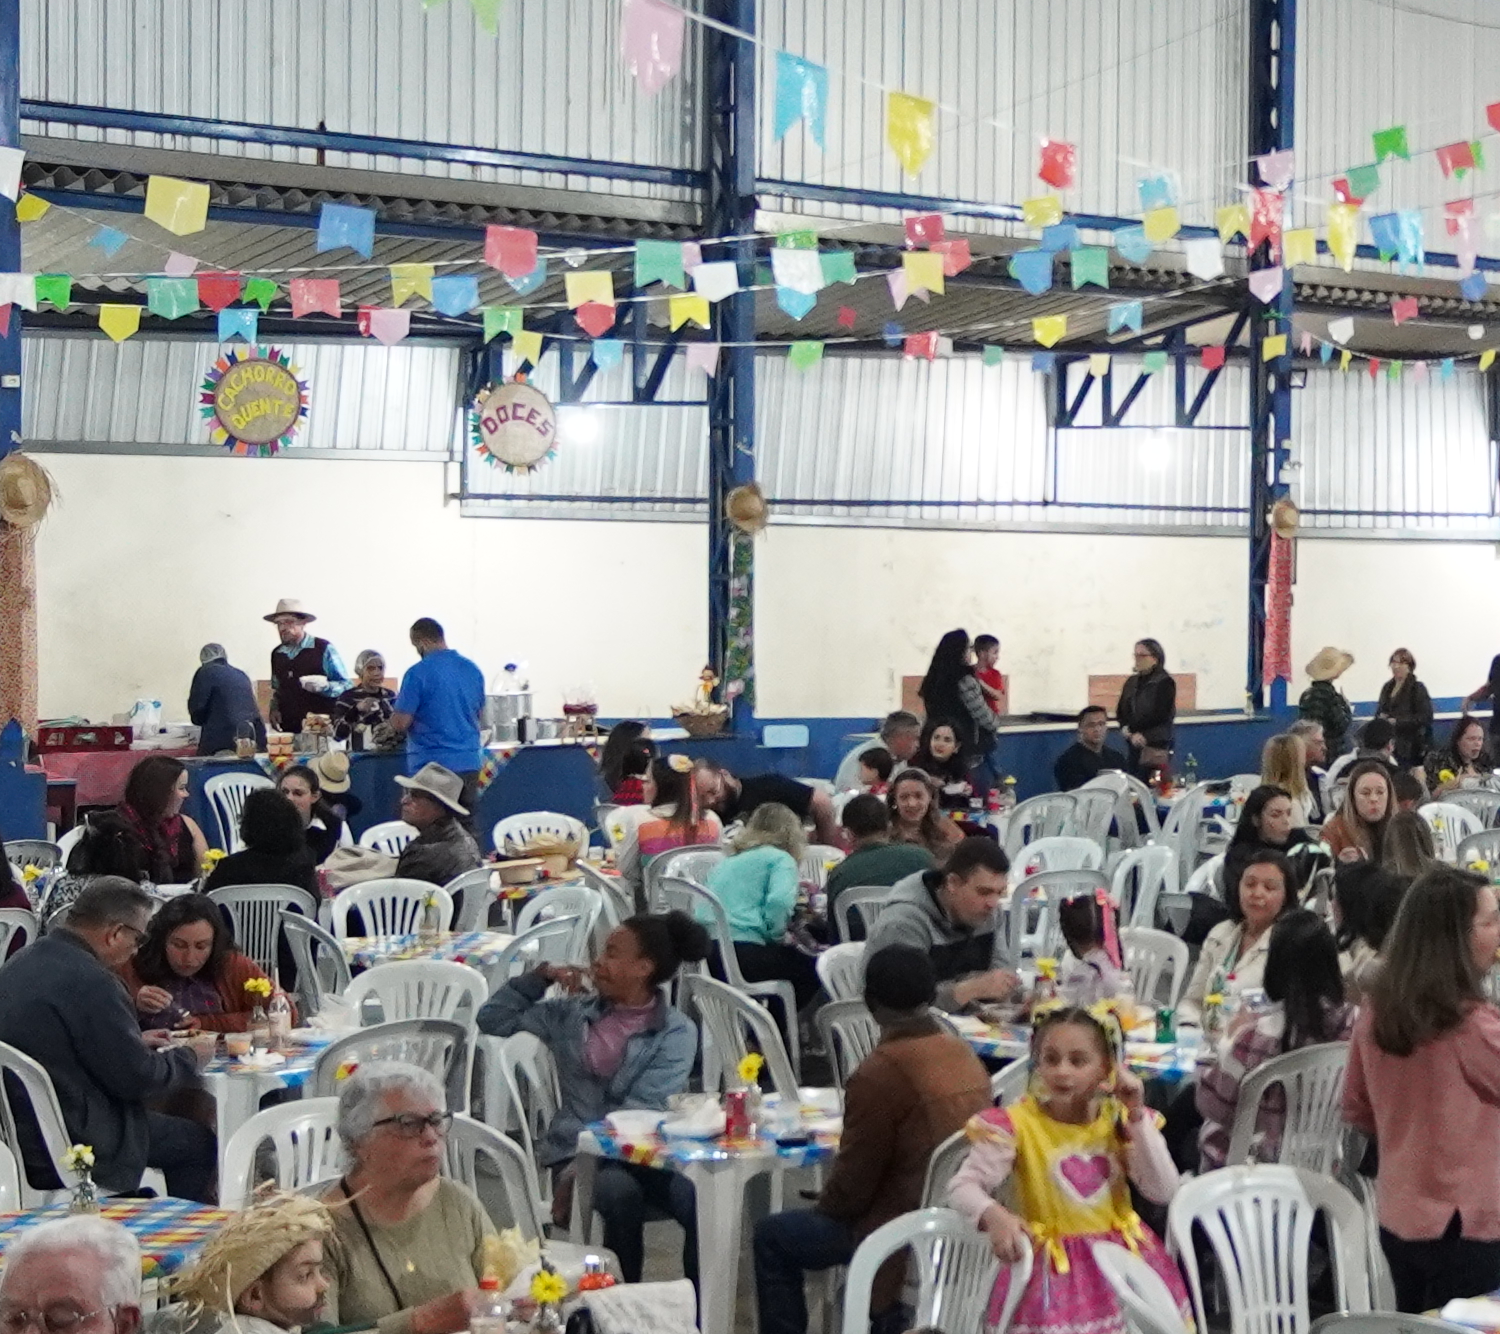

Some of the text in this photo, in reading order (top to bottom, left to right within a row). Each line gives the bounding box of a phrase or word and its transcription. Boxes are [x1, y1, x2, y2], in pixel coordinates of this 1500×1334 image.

[217, 365, 297, 411] CACHORRO
[231, 397, 295, 430] QUENTE
[481, 402, 554, 436] DOCES
